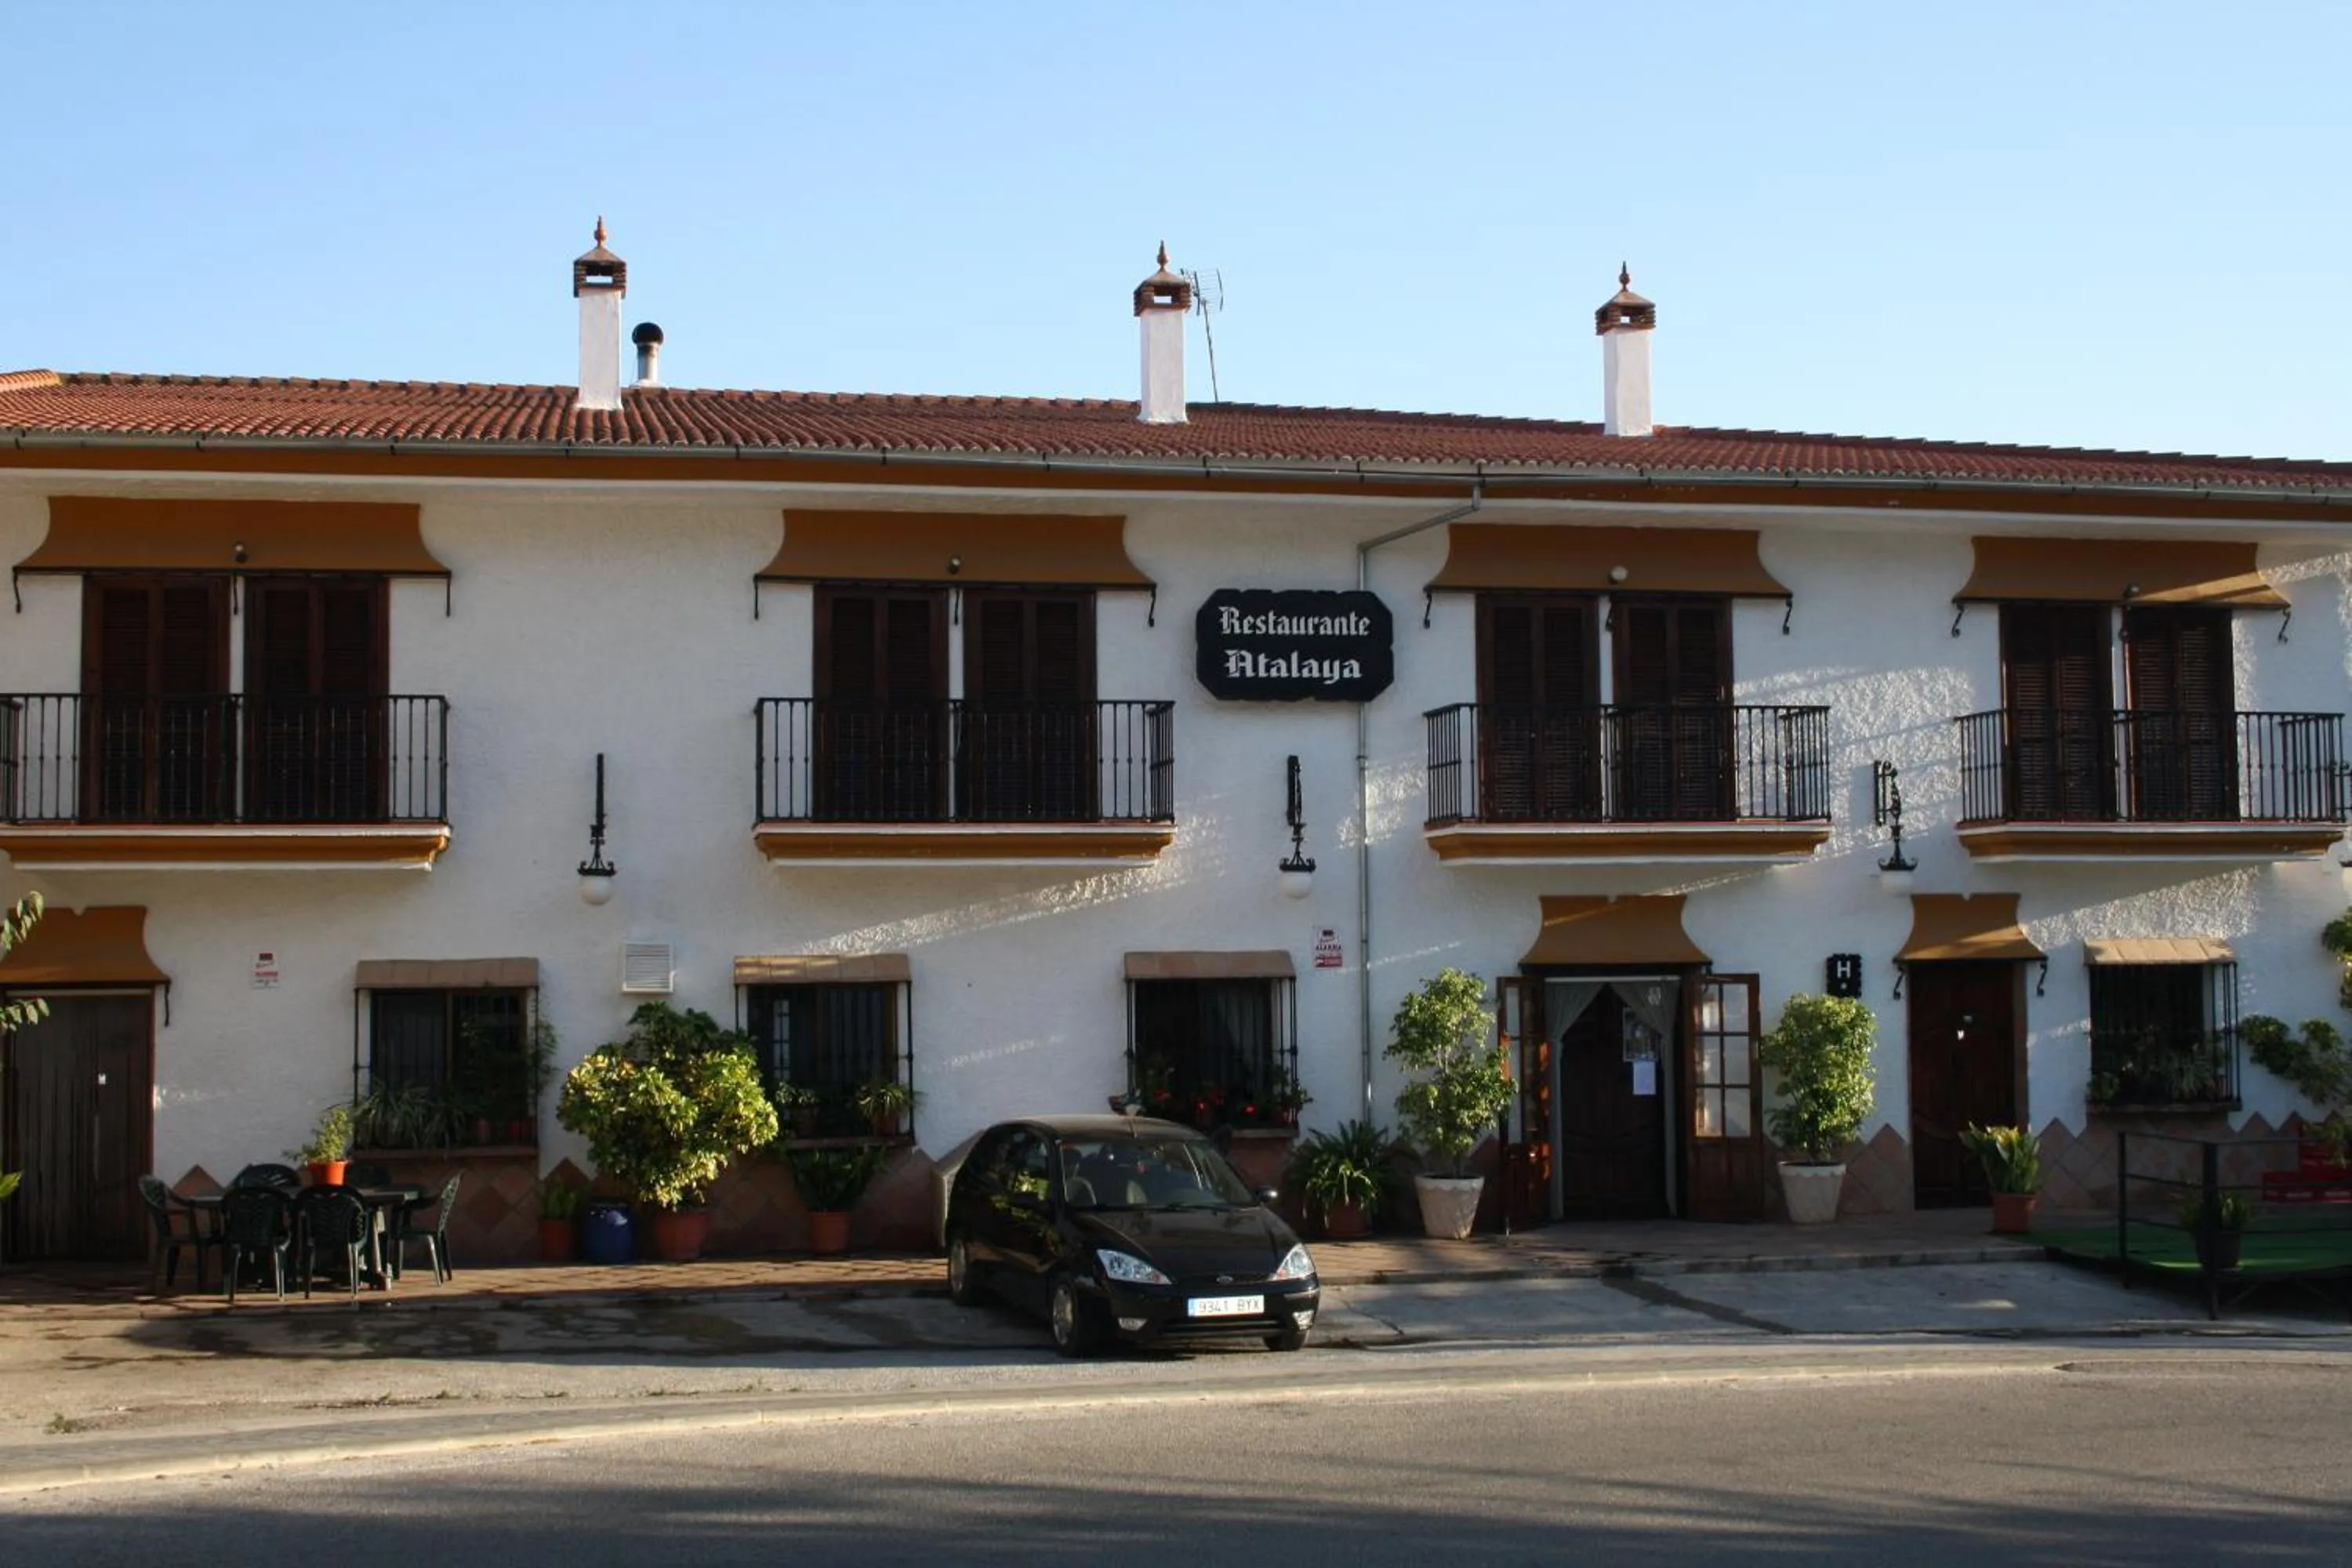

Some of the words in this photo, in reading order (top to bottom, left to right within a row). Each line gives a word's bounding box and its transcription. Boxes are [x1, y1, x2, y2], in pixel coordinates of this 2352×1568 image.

[1218, 606, 1370, 636] Restaurante
[1224, 649, 1362, 684] Atalaya
[1837, 960, 1850, 978] H
